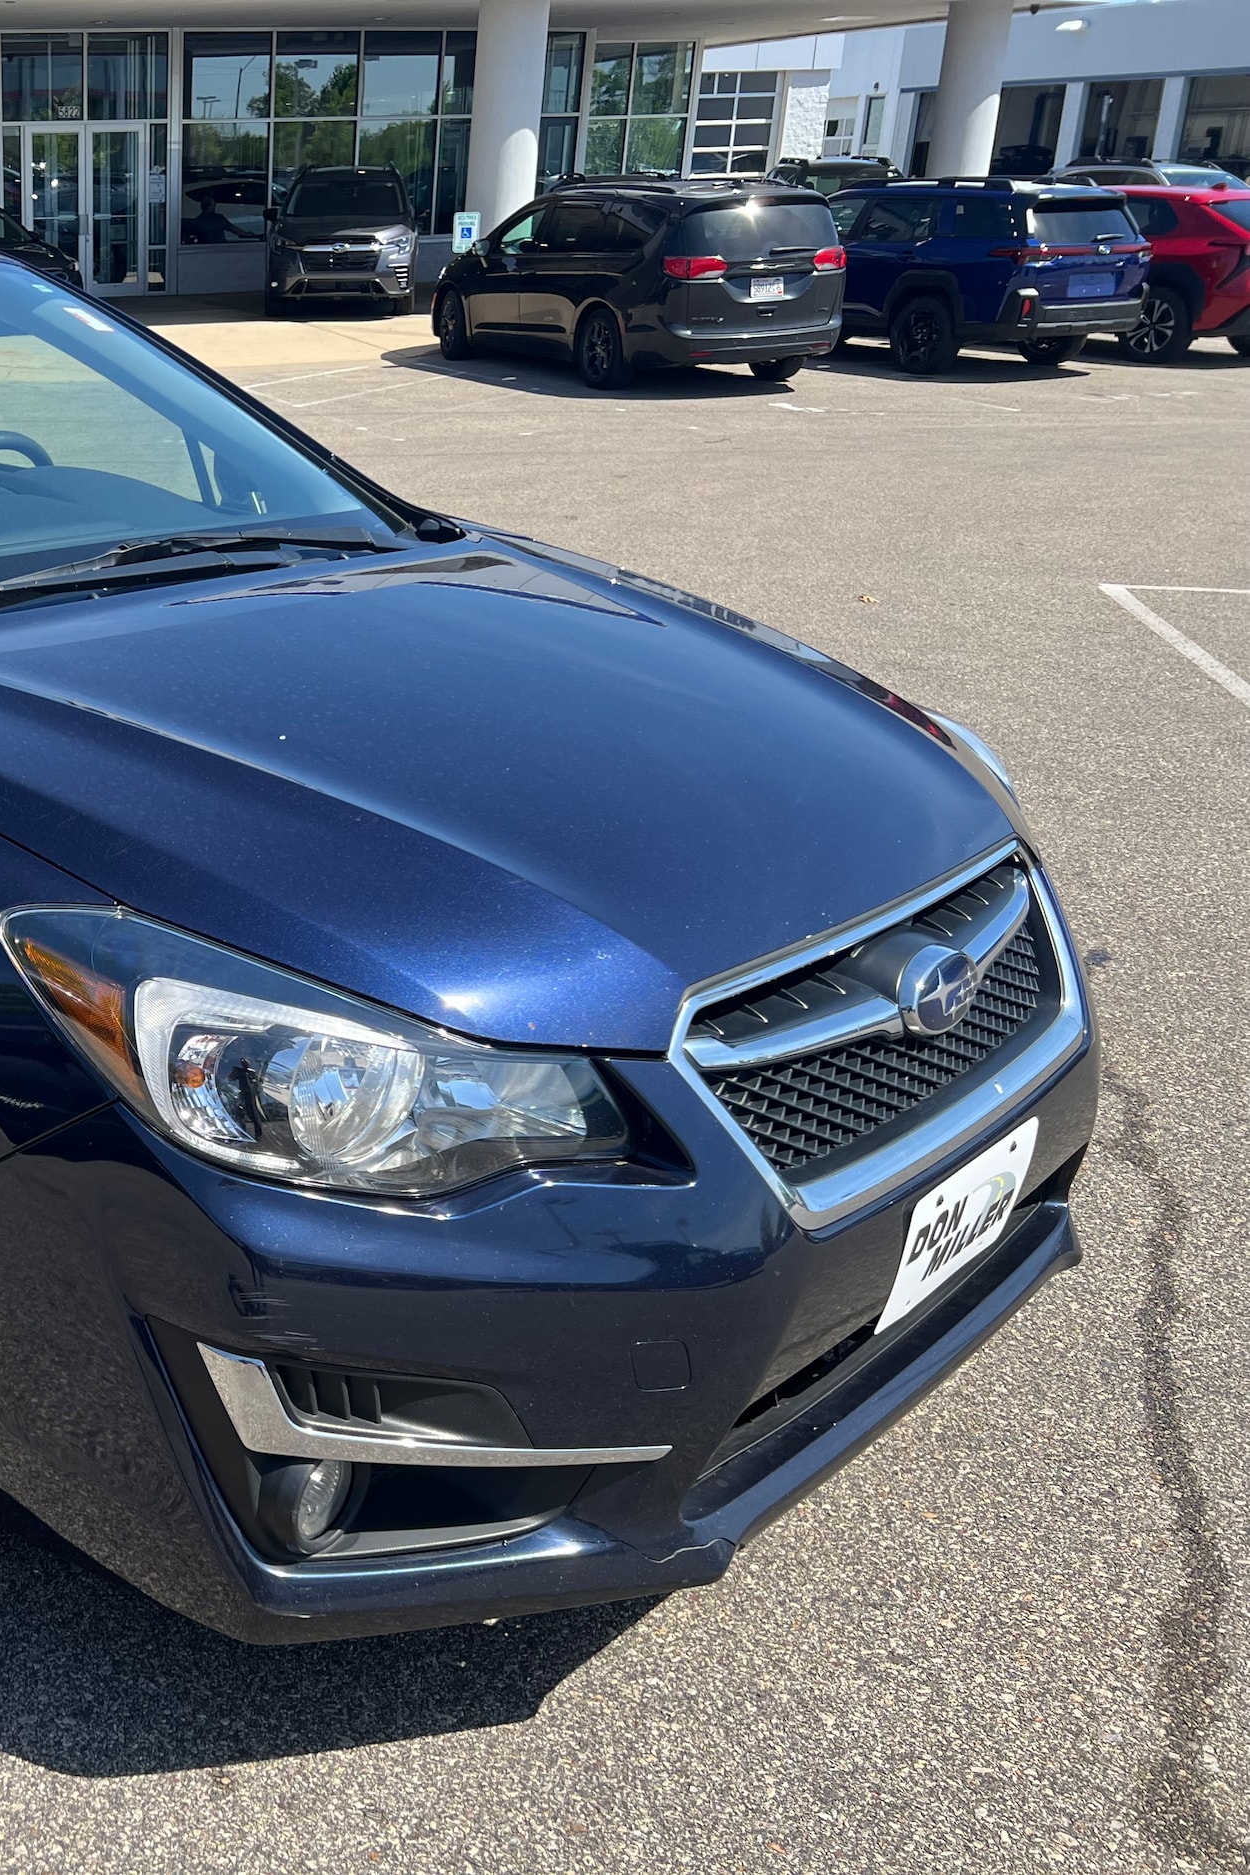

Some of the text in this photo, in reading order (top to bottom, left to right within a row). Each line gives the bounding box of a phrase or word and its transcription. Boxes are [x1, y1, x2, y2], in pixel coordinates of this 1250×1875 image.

[59, 106, 80, 118] 5822
[906, 1194, 969, 1267] DON
[920, 1188, 1015, 1282] MILLER
